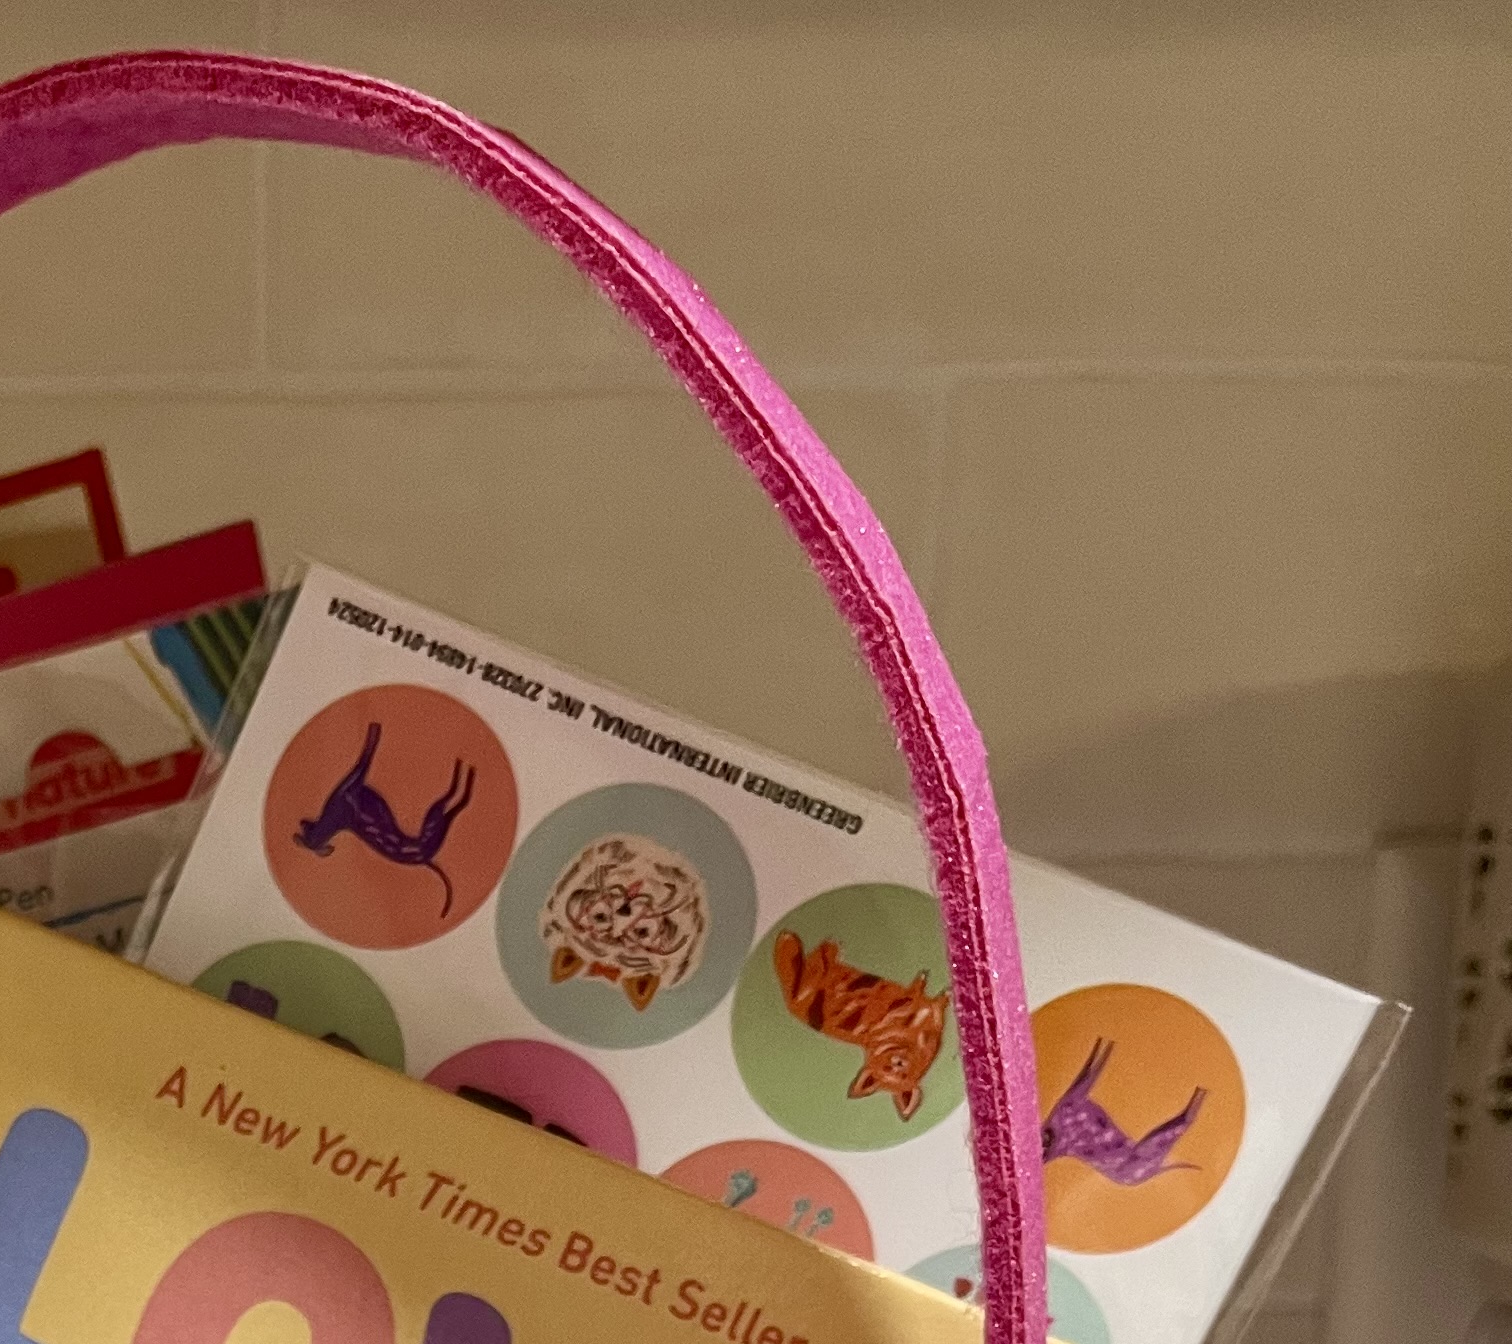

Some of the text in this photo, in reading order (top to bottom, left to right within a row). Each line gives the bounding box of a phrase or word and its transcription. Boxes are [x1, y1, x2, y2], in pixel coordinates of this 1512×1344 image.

[743, 769, 864, 836] GREENBRIER
[155, 1065, 187, 1109] A
[200, 1083, 301, 1152] New
[311, 1125, 408, 1200] York
[419, 1170, 552, 1258] Times
[558, 1230, 662, 1307] Best
